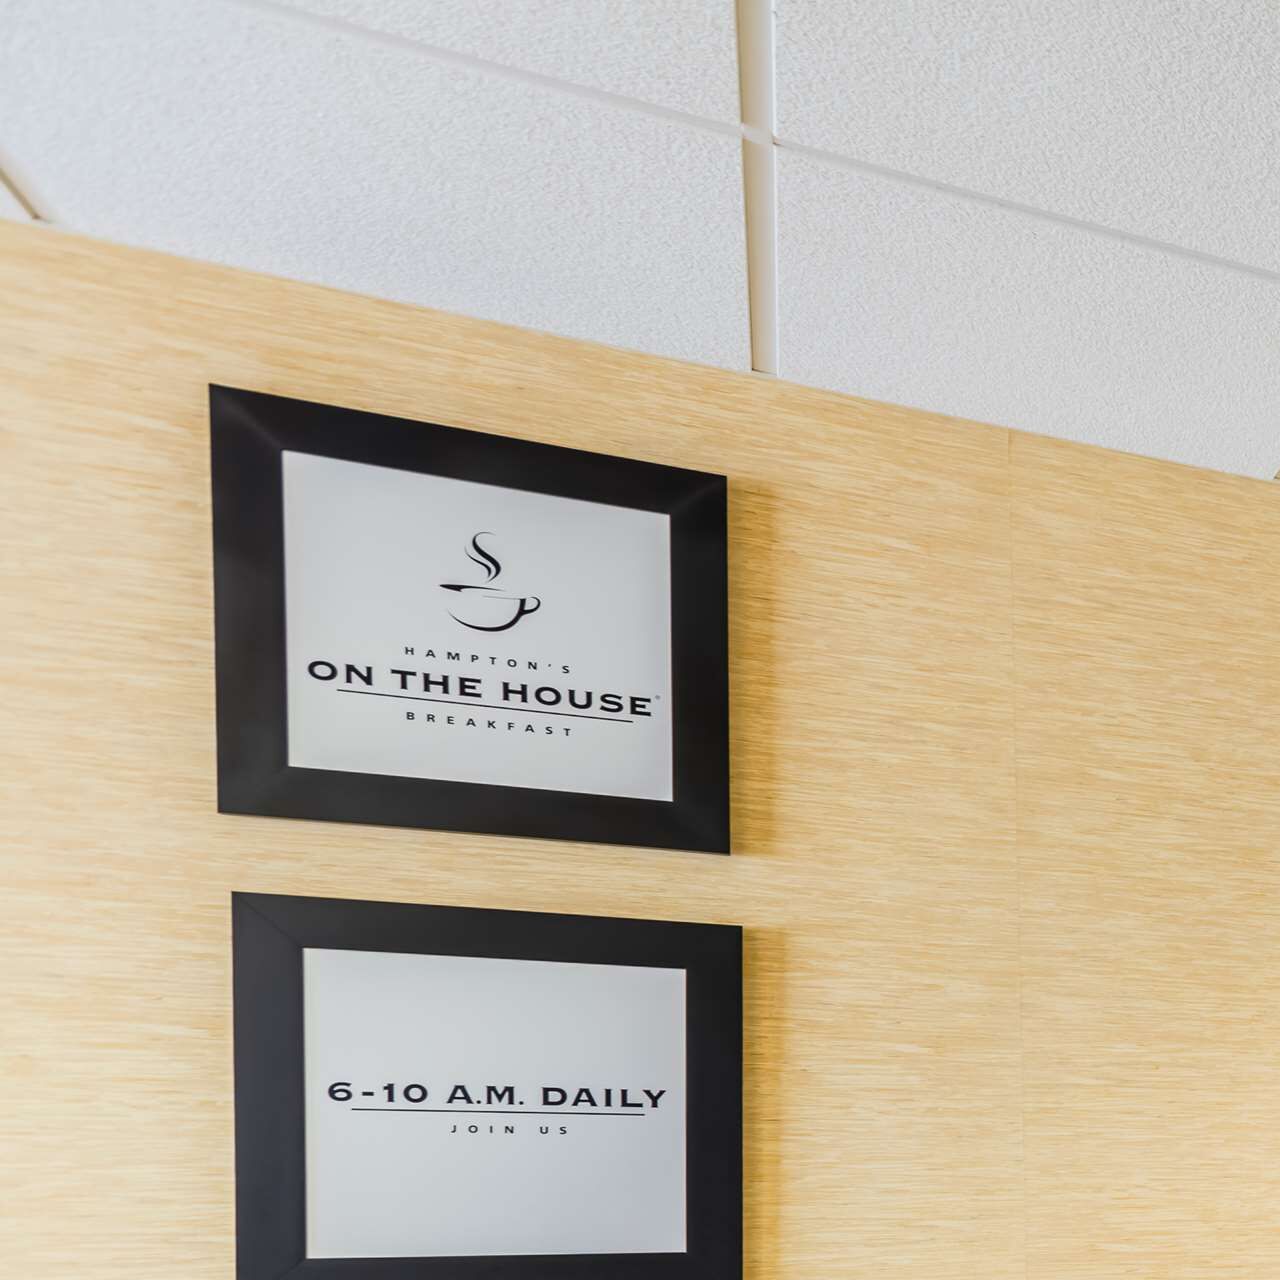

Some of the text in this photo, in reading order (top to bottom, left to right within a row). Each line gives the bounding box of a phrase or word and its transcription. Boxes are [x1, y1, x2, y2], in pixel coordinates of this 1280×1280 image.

[404, 646, 570, 674] HAMPTON'S
[307, 660, 652, 718] ON THE HOUSE
[406, 711, 572, 737] BREAKFAST
[327, 1081, 667, 1108] 6-10 A.M. DAILY
[450, 1124, 568, 1135] JOIN US
